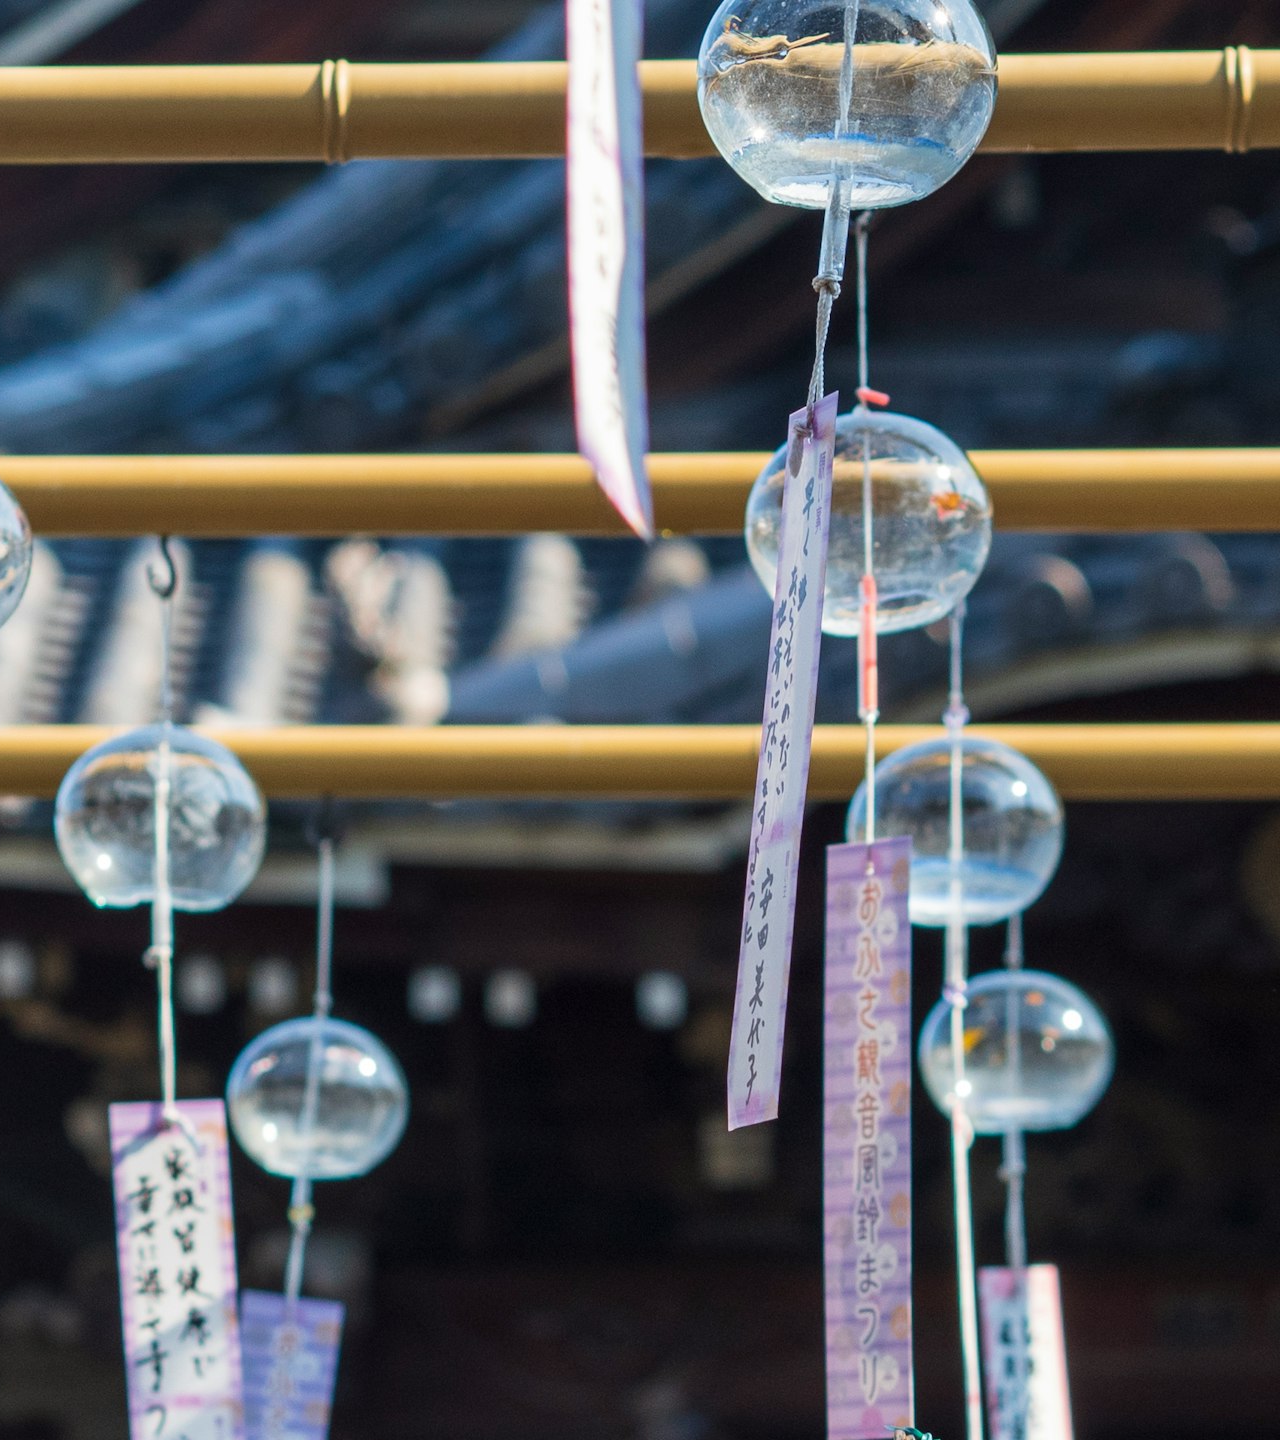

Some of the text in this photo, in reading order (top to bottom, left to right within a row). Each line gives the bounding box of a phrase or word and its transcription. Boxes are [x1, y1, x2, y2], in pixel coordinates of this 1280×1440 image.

[854, 879, 881, 1404] おふさ観音風鈴まつり
